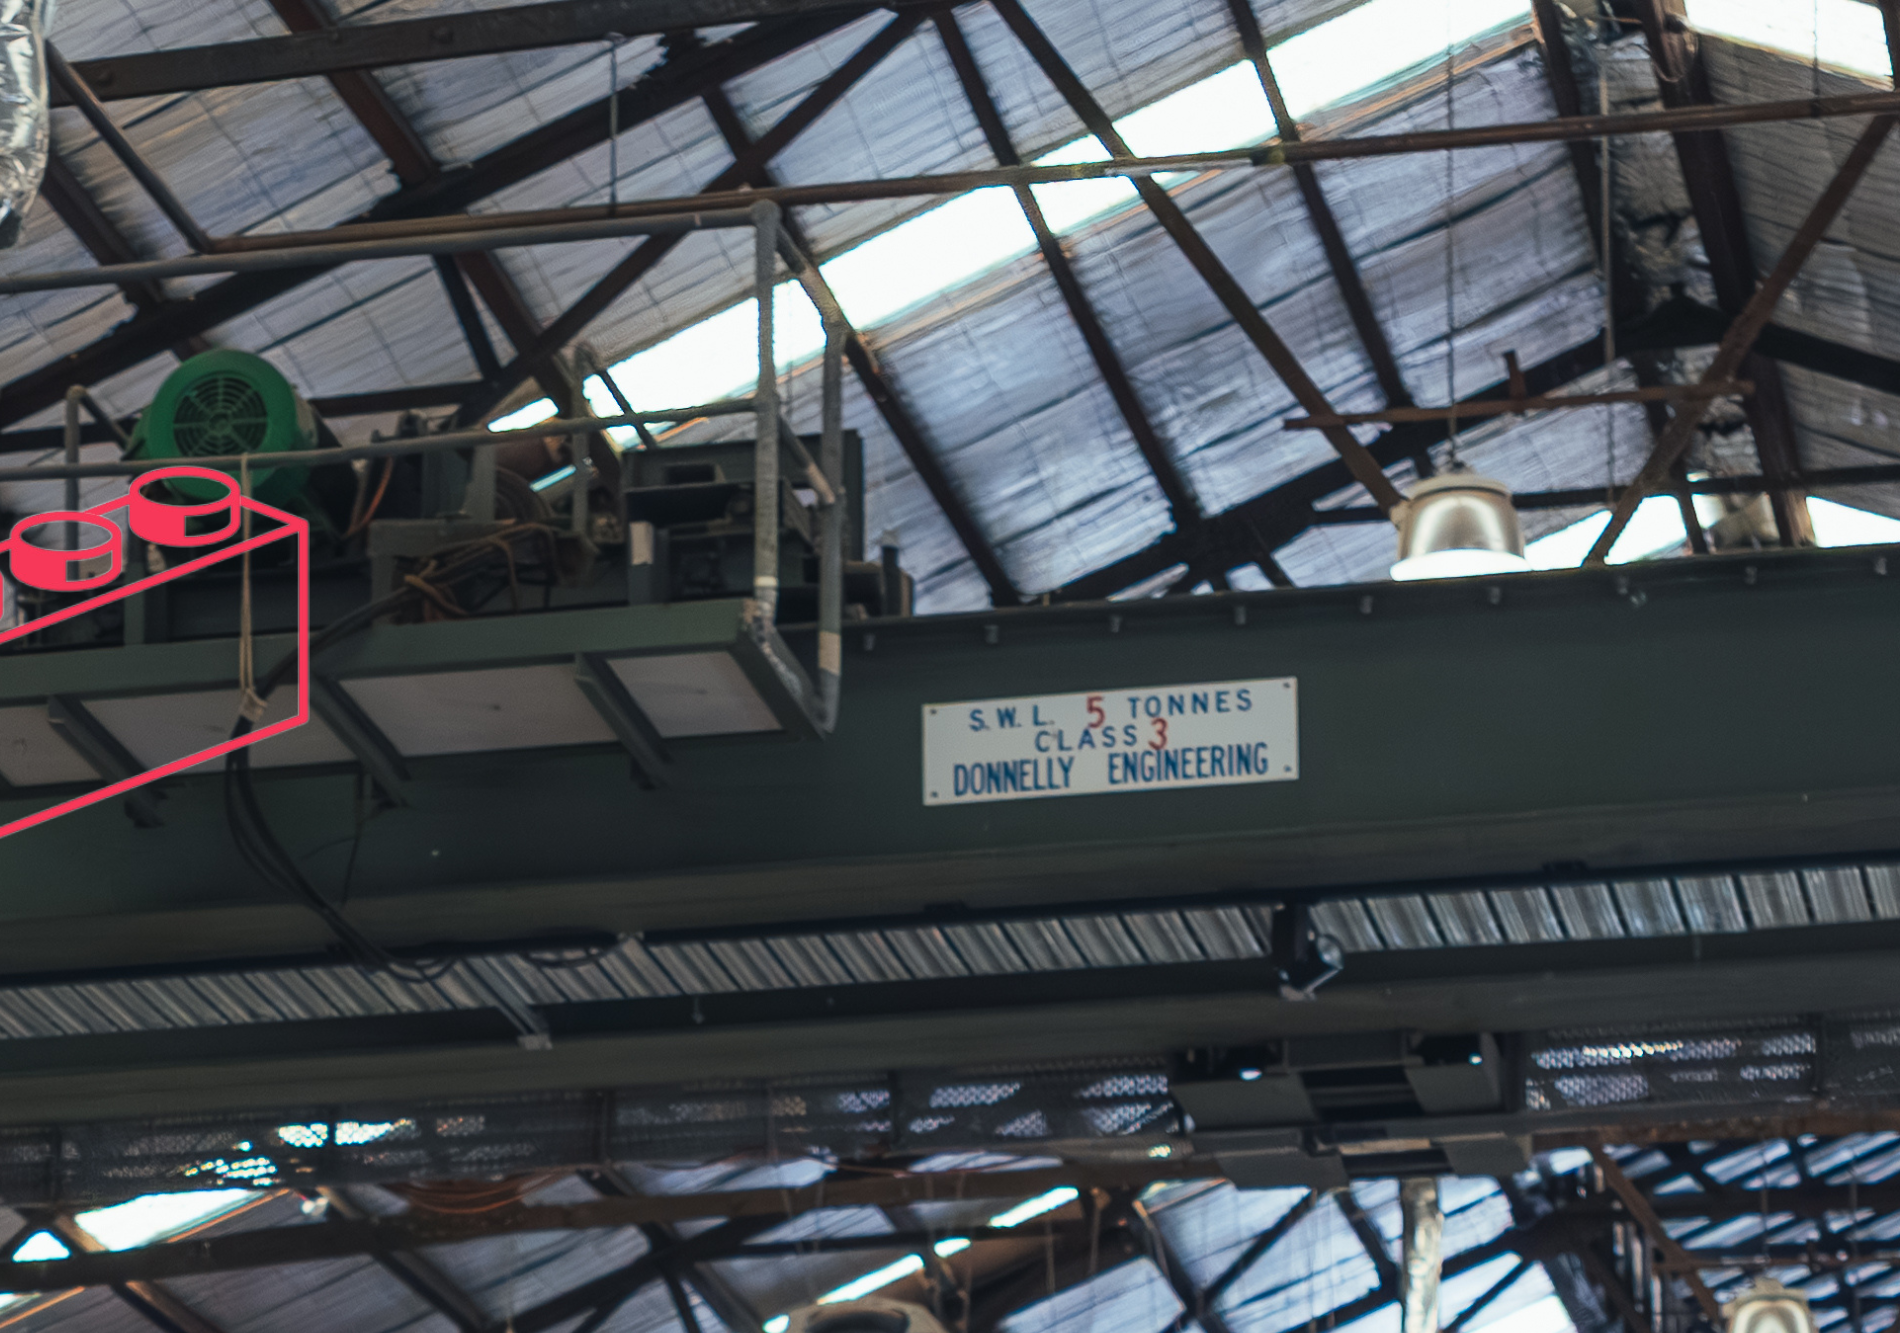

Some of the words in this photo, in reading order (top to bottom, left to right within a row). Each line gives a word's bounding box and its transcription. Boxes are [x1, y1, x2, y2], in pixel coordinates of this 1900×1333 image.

[1086, 696, 1106, 729] 5
[1128, 689, 1253, 720] TONNES
[1034, 725, 1139, 753] CLASS
[1148, 718, 1169, 752] 3
[953, 756, 1076, 797] DONNELLY
[1108, 742, 1269, 786] ENGINEERING
